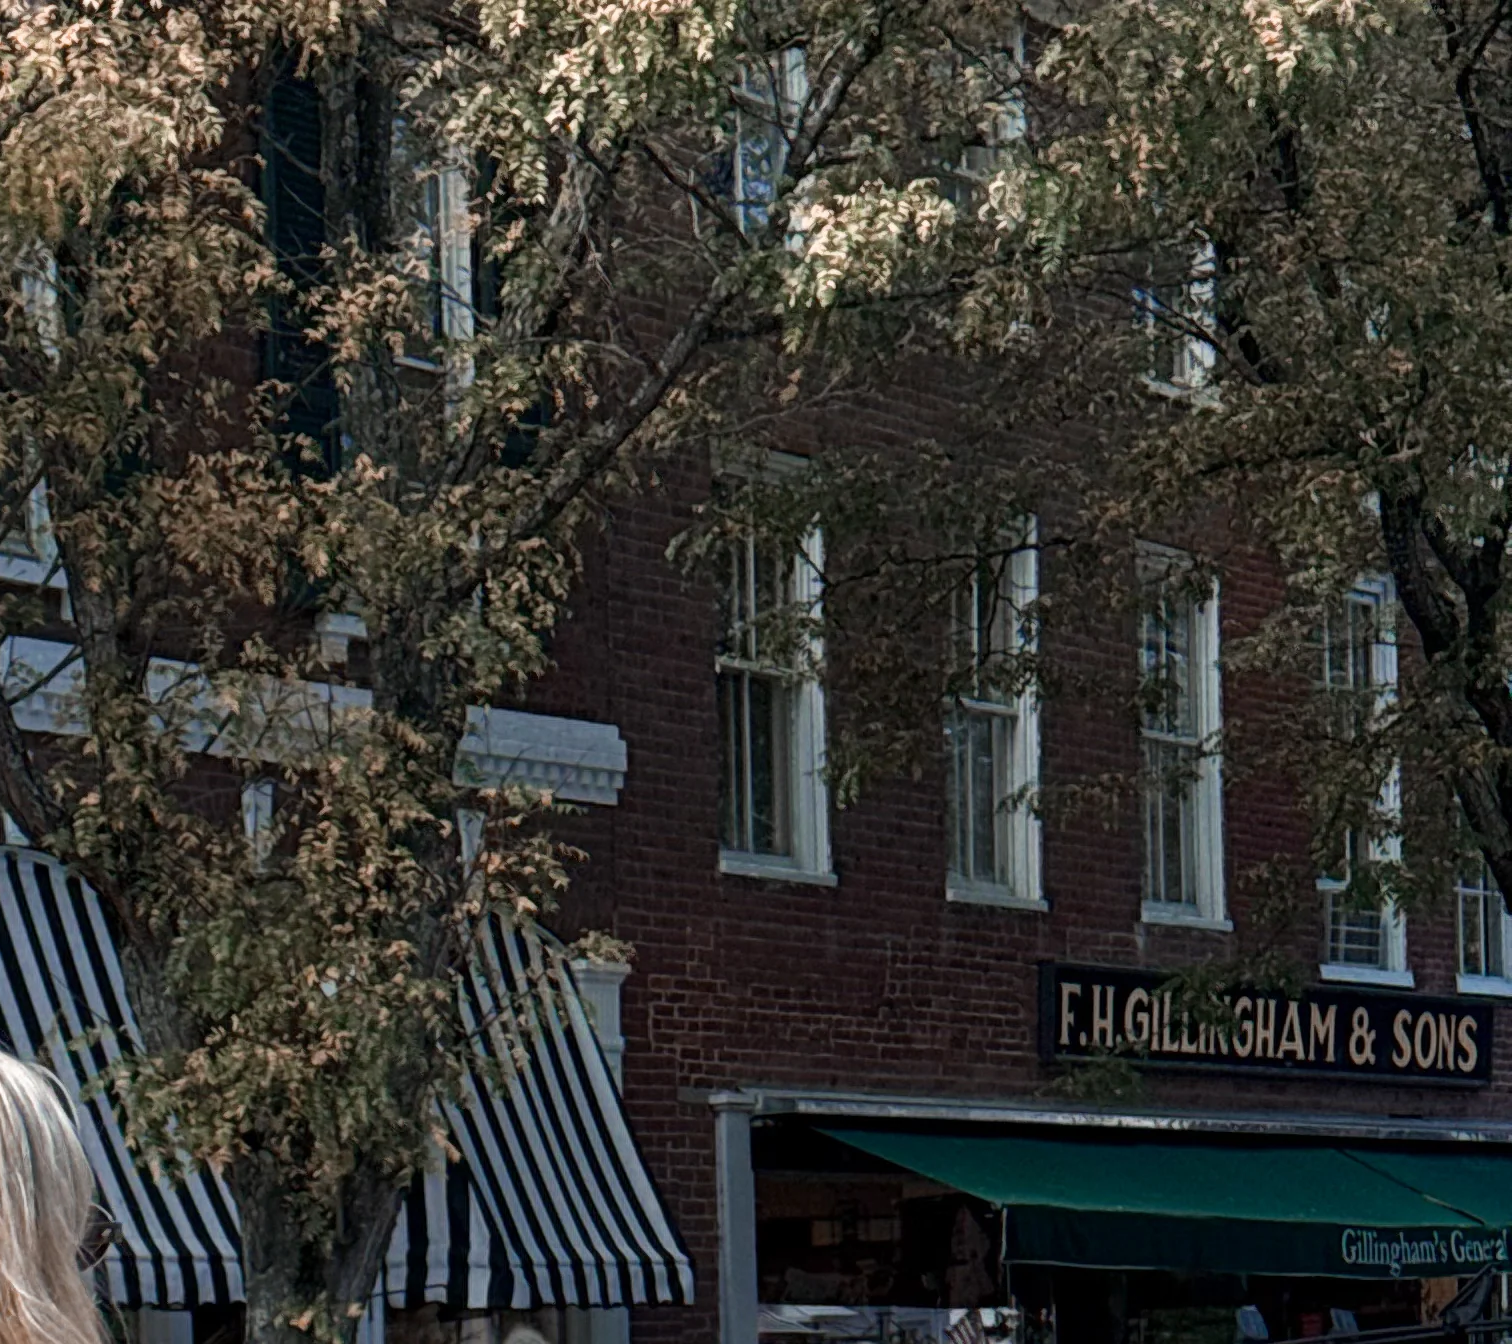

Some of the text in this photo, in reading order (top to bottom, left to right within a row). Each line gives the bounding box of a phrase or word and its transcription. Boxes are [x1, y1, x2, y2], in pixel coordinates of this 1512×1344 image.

[1349, 1006, 1377, 1066] &
[1392, 1008, 1478, 1074] SONS
[1341, 1228, 1509, 1278] Gillingham's General
